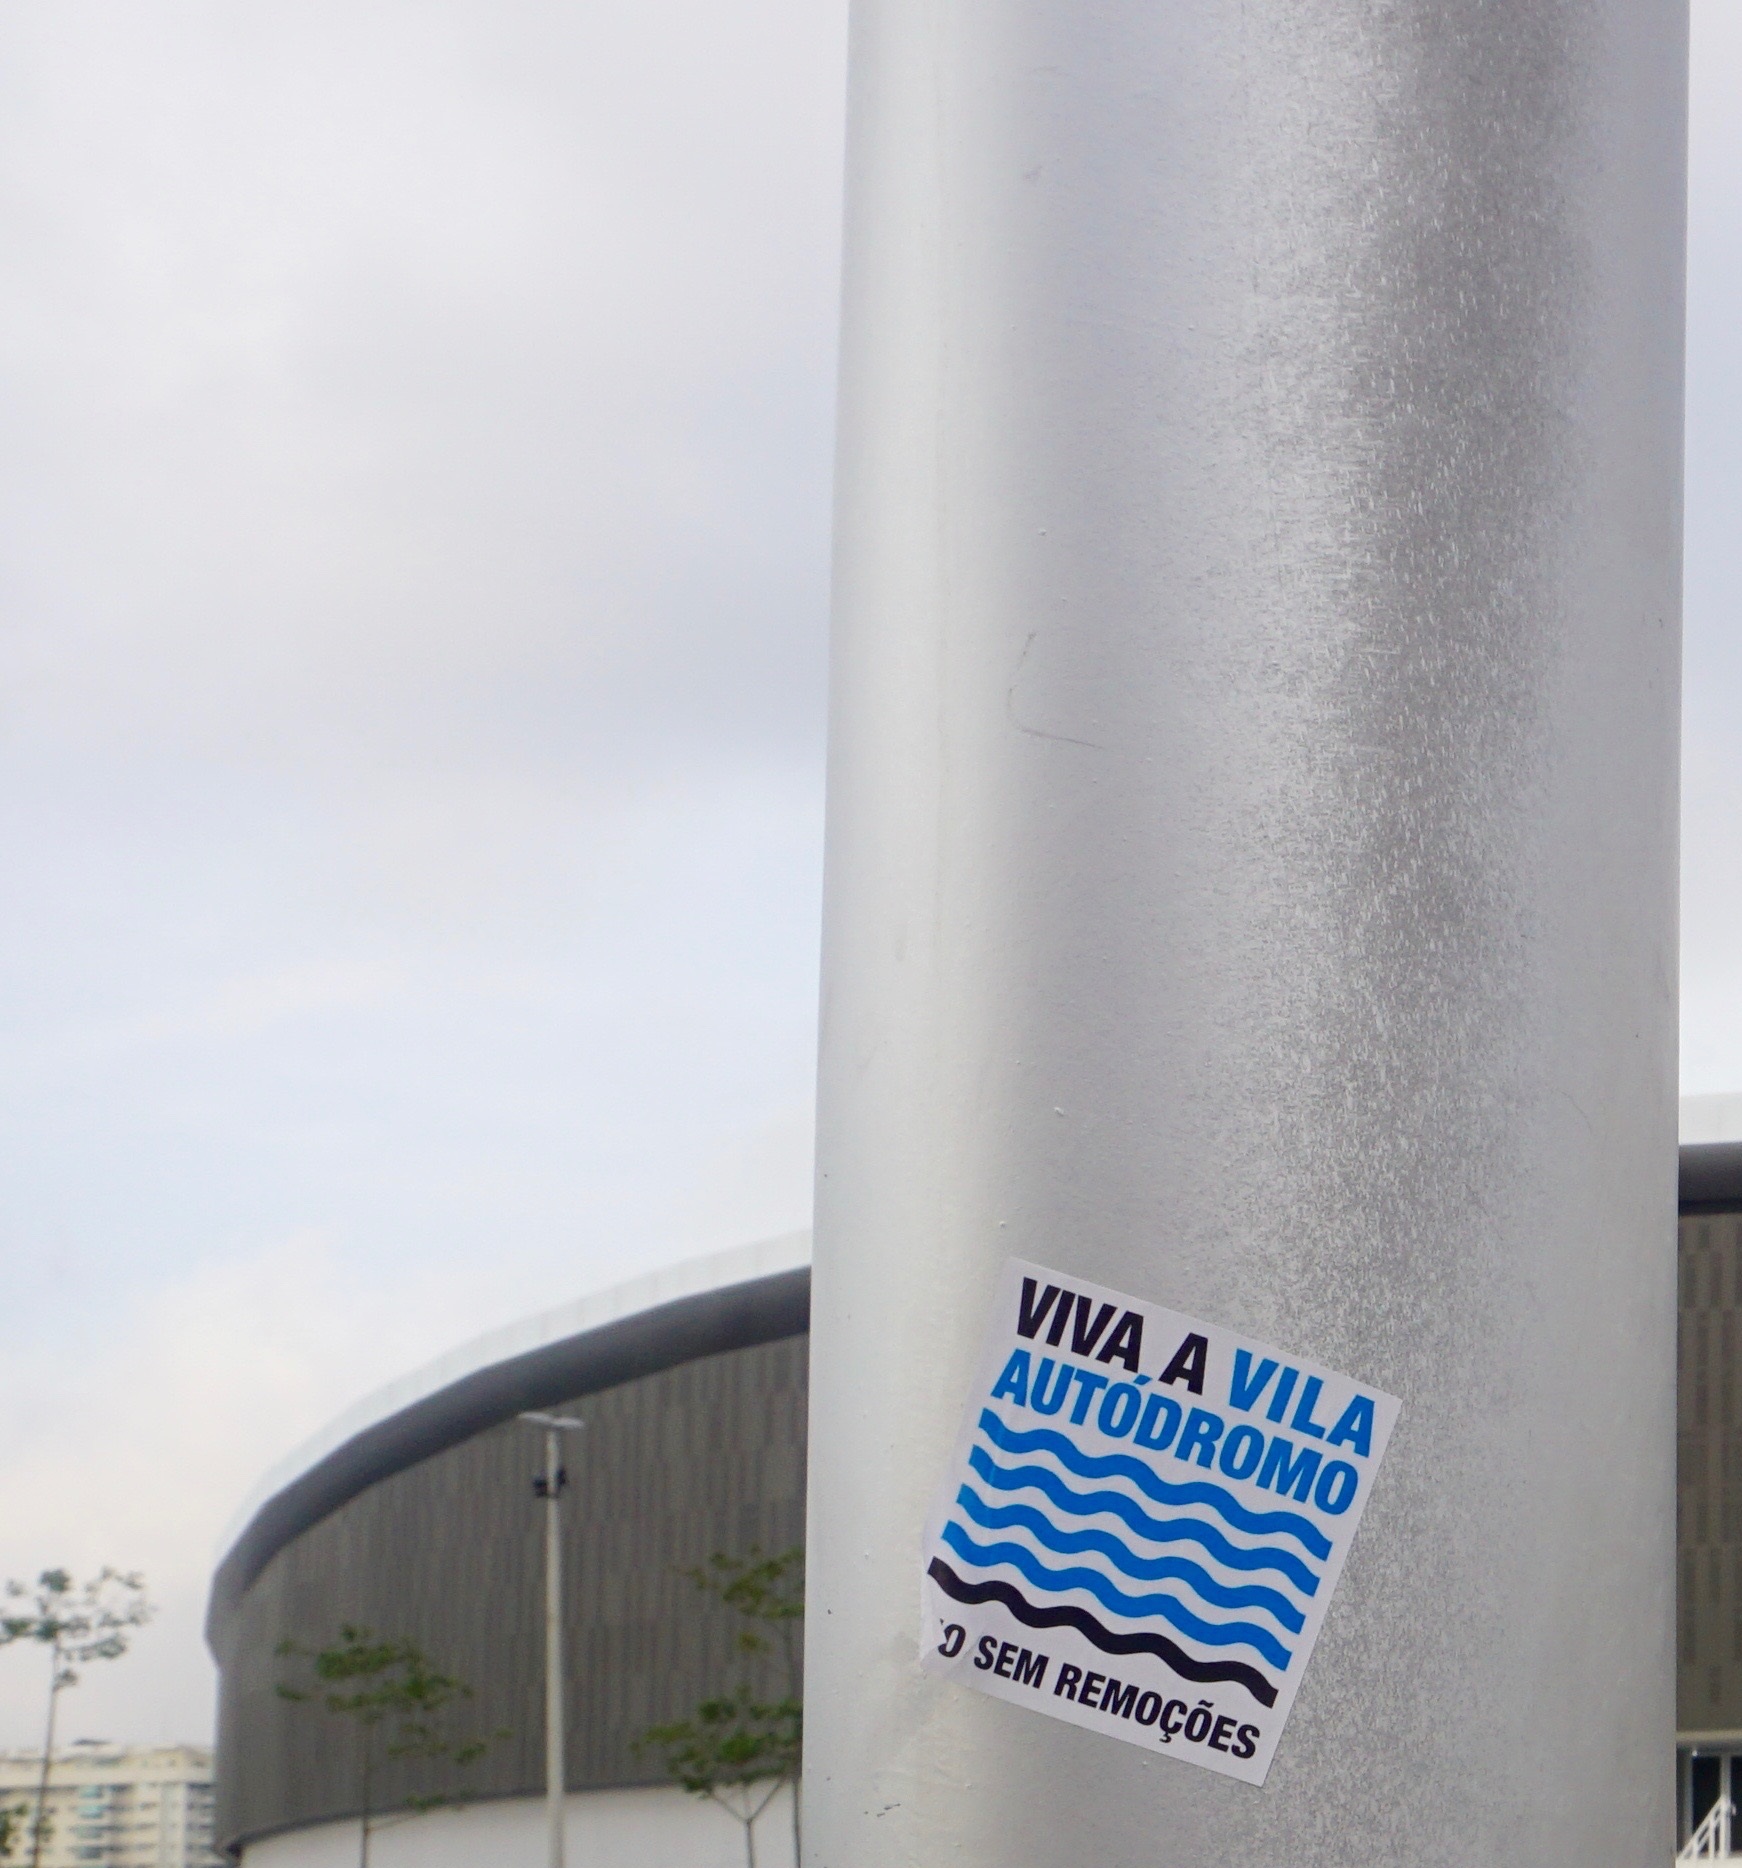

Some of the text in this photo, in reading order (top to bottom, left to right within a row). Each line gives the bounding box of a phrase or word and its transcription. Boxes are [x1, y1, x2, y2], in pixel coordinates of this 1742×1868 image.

[990, 1348, 1359, 1516] AUTÓDROMO
[1016, 1276, 1375, 1458] VIVA A VILA
[973, 1635, 1050, 1689] SEM
[1053, 1662, 1261, 1759] REMOÇÕES
